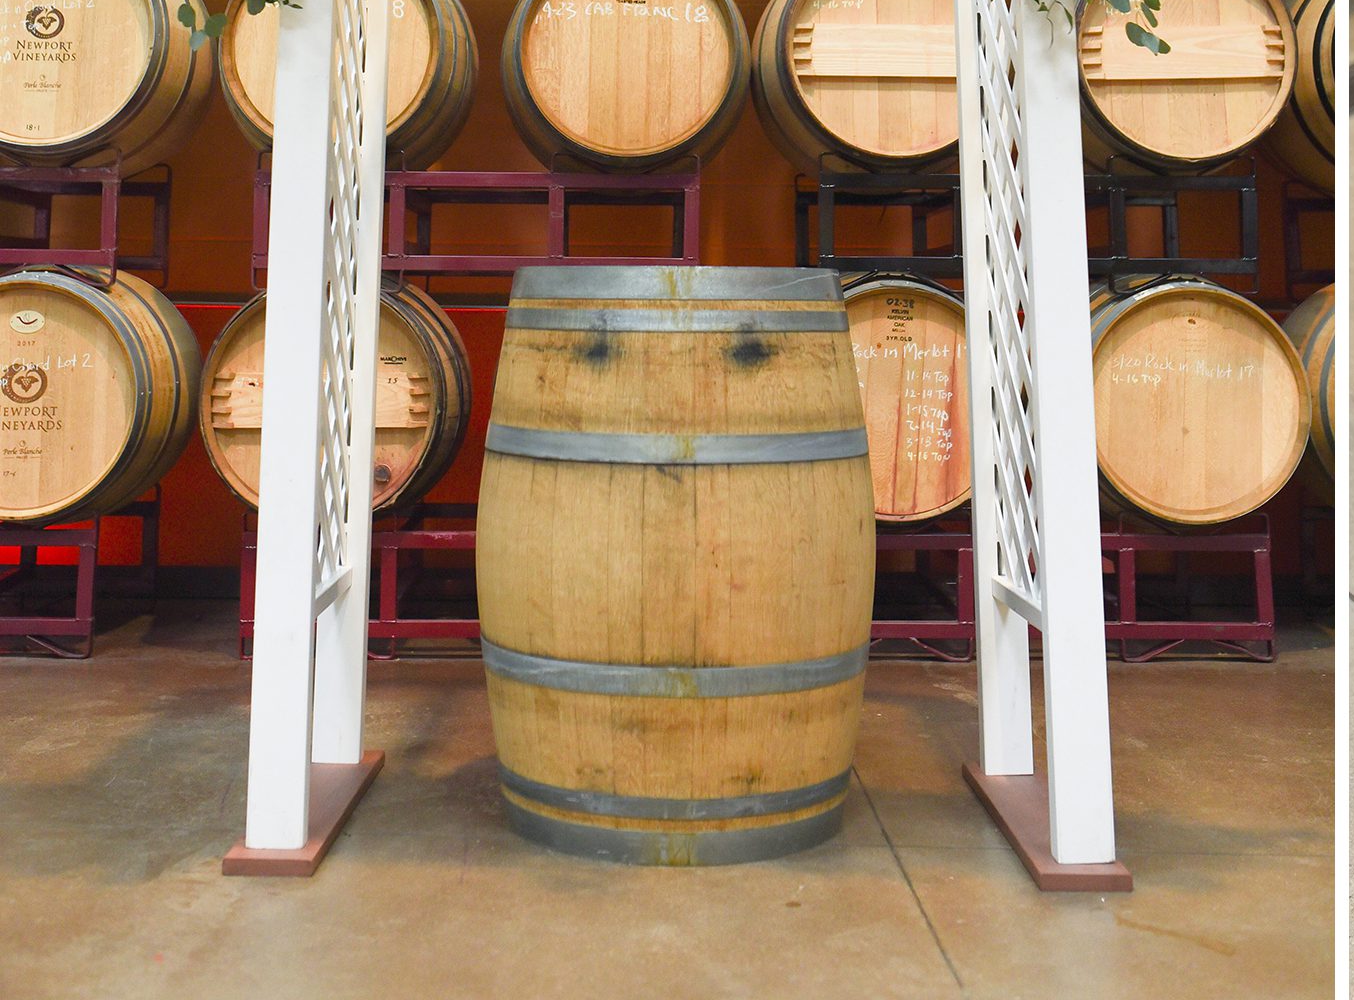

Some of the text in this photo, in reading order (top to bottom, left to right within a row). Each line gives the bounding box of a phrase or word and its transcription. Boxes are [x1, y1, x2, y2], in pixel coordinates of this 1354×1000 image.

[16, 40, 73, 52] NEWPORT
[12, 50, 77, 63] VINEYARDS
[39, 81, 62, 89] Blanche
[884, 347, 898, 358] in
[903, 343, 950, 360] Merlot
[57, 354, 78, 369] Lot
[82, 353, 94, 368] 2
[934, 371, 949, 387] Top
[937, 389, 953, 402] Top
[2, 447, 43, 456] Perle Blanche
